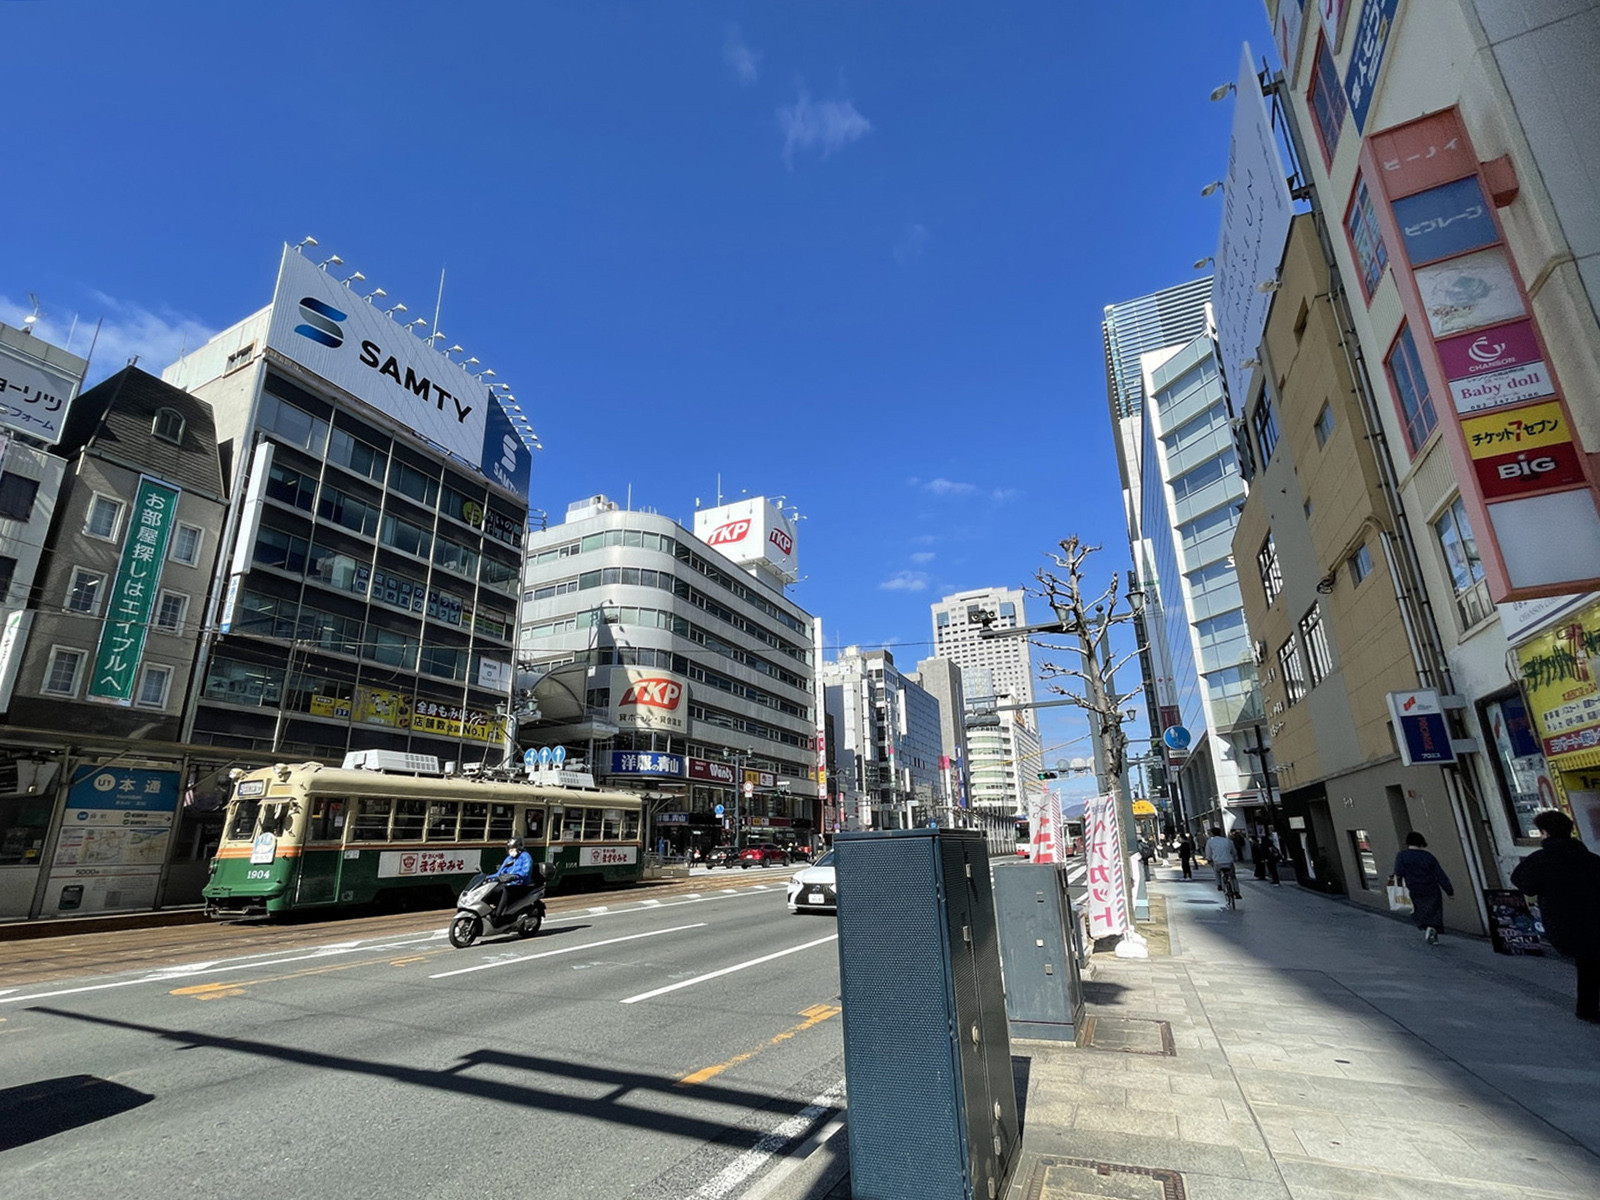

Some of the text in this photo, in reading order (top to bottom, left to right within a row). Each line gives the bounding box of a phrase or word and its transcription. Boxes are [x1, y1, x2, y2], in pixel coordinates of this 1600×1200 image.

[1468, 356, 1516, 372] CHANSON
[359, 339, 473, 424] SAMTY
[1461, 382, 1502, 400] Baby
[1507, 373, 1540, 390] doll
[711, 522, 748, 545] TKP
[771, 530, 791, 550] TKP
[100, 492, 166, 691] お部屋探しはエイブルへ
[628, 682, 680, 704] TKP
[621, 753, 679, 773] 洋服の青山
[709, 762, 733, 783] Wants
[246, 870, 270, 880] 1904
[419, 859, 464, 873] ますやみそ
